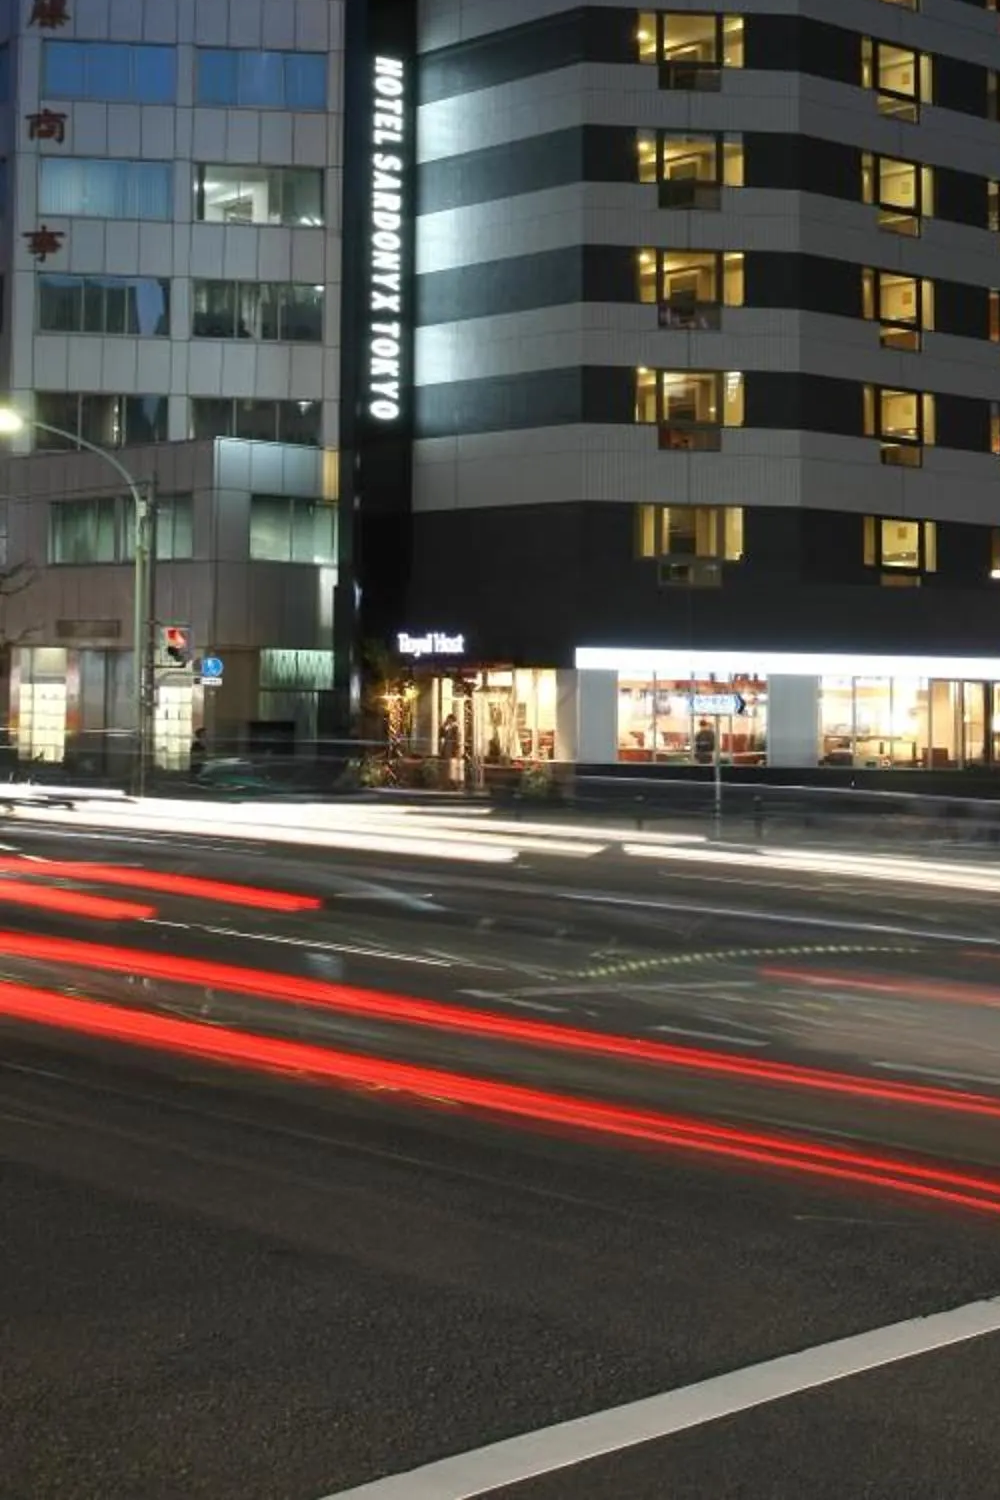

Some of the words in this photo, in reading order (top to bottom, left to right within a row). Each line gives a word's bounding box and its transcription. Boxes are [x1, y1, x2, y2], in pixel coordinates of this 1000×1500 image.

[373, 56, 404, 145] HOTEL
[371, 153, 403, 313] SARDONYX
[369, 322, 400, 420] TOKYO
